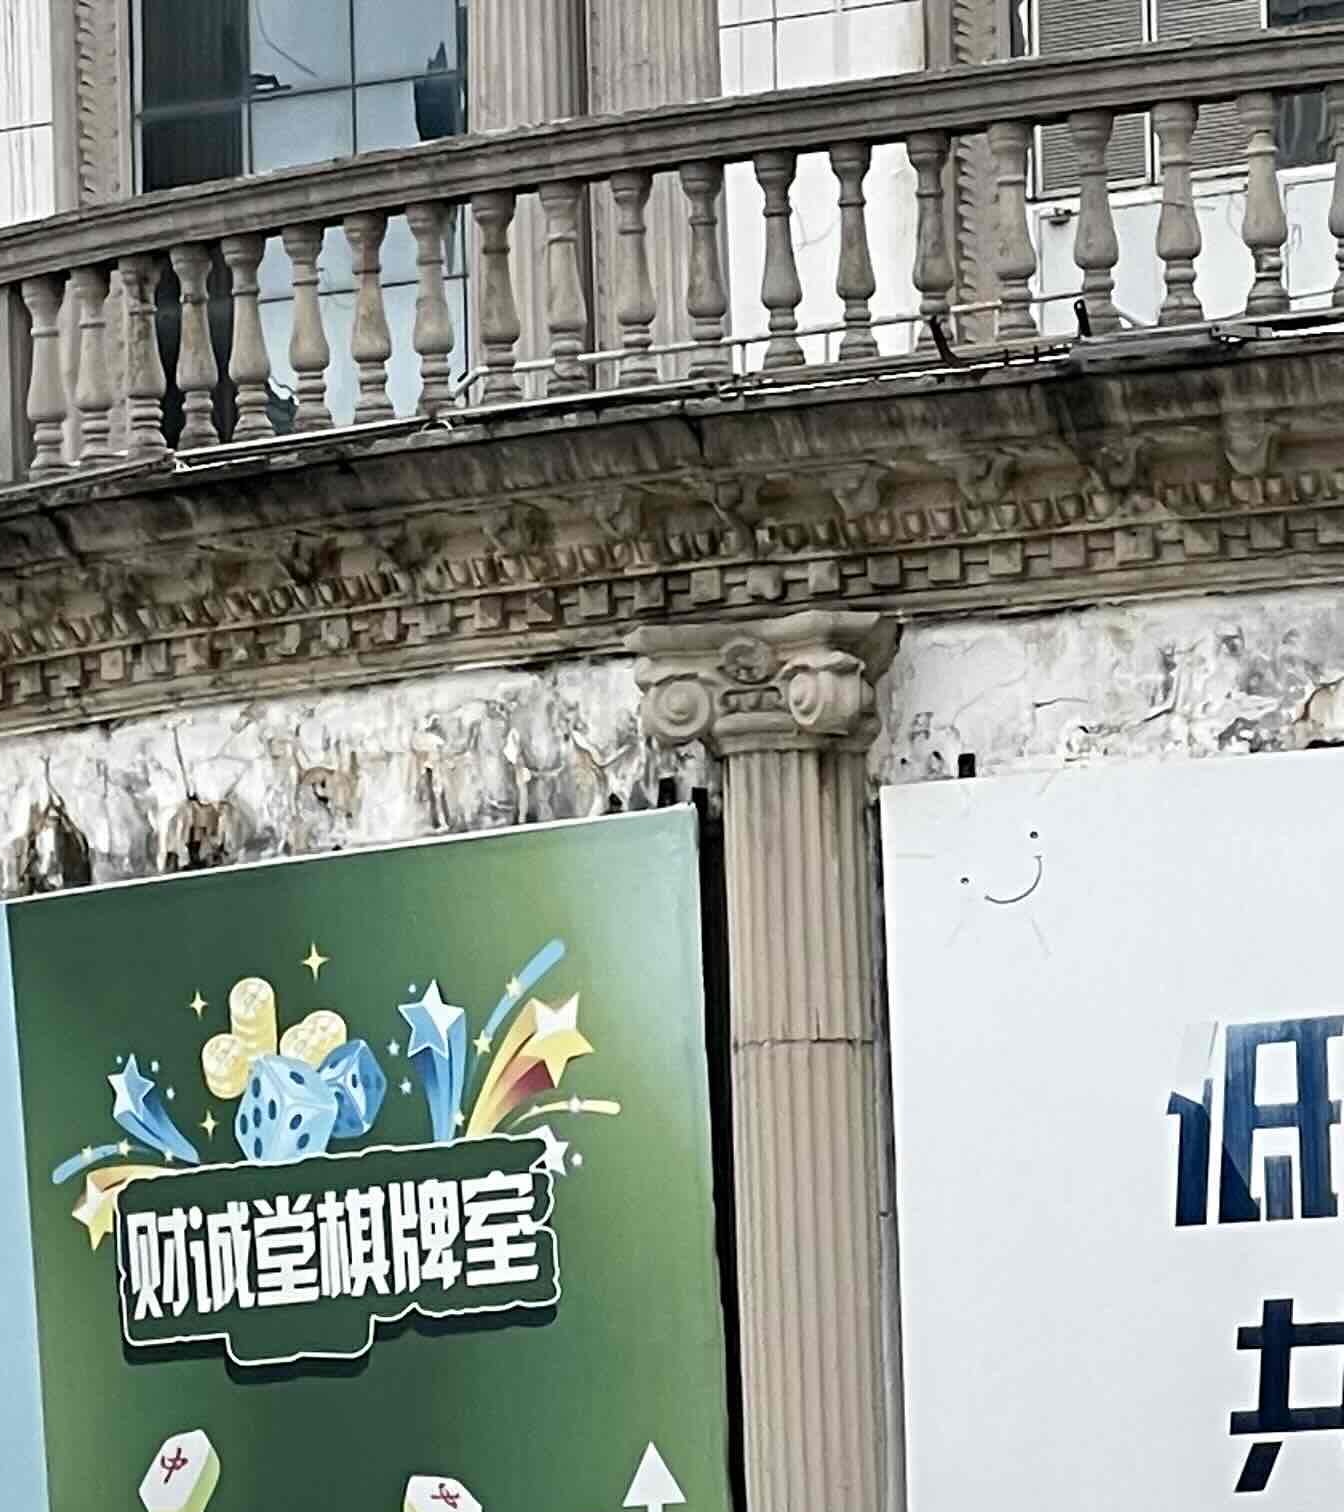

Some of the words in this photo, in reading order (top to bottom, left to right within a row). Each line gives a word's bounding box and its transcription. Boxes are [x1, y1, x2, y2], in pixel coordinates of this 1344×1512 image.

[126, 1172, 540, 1321] 财诚堂棋牌室
